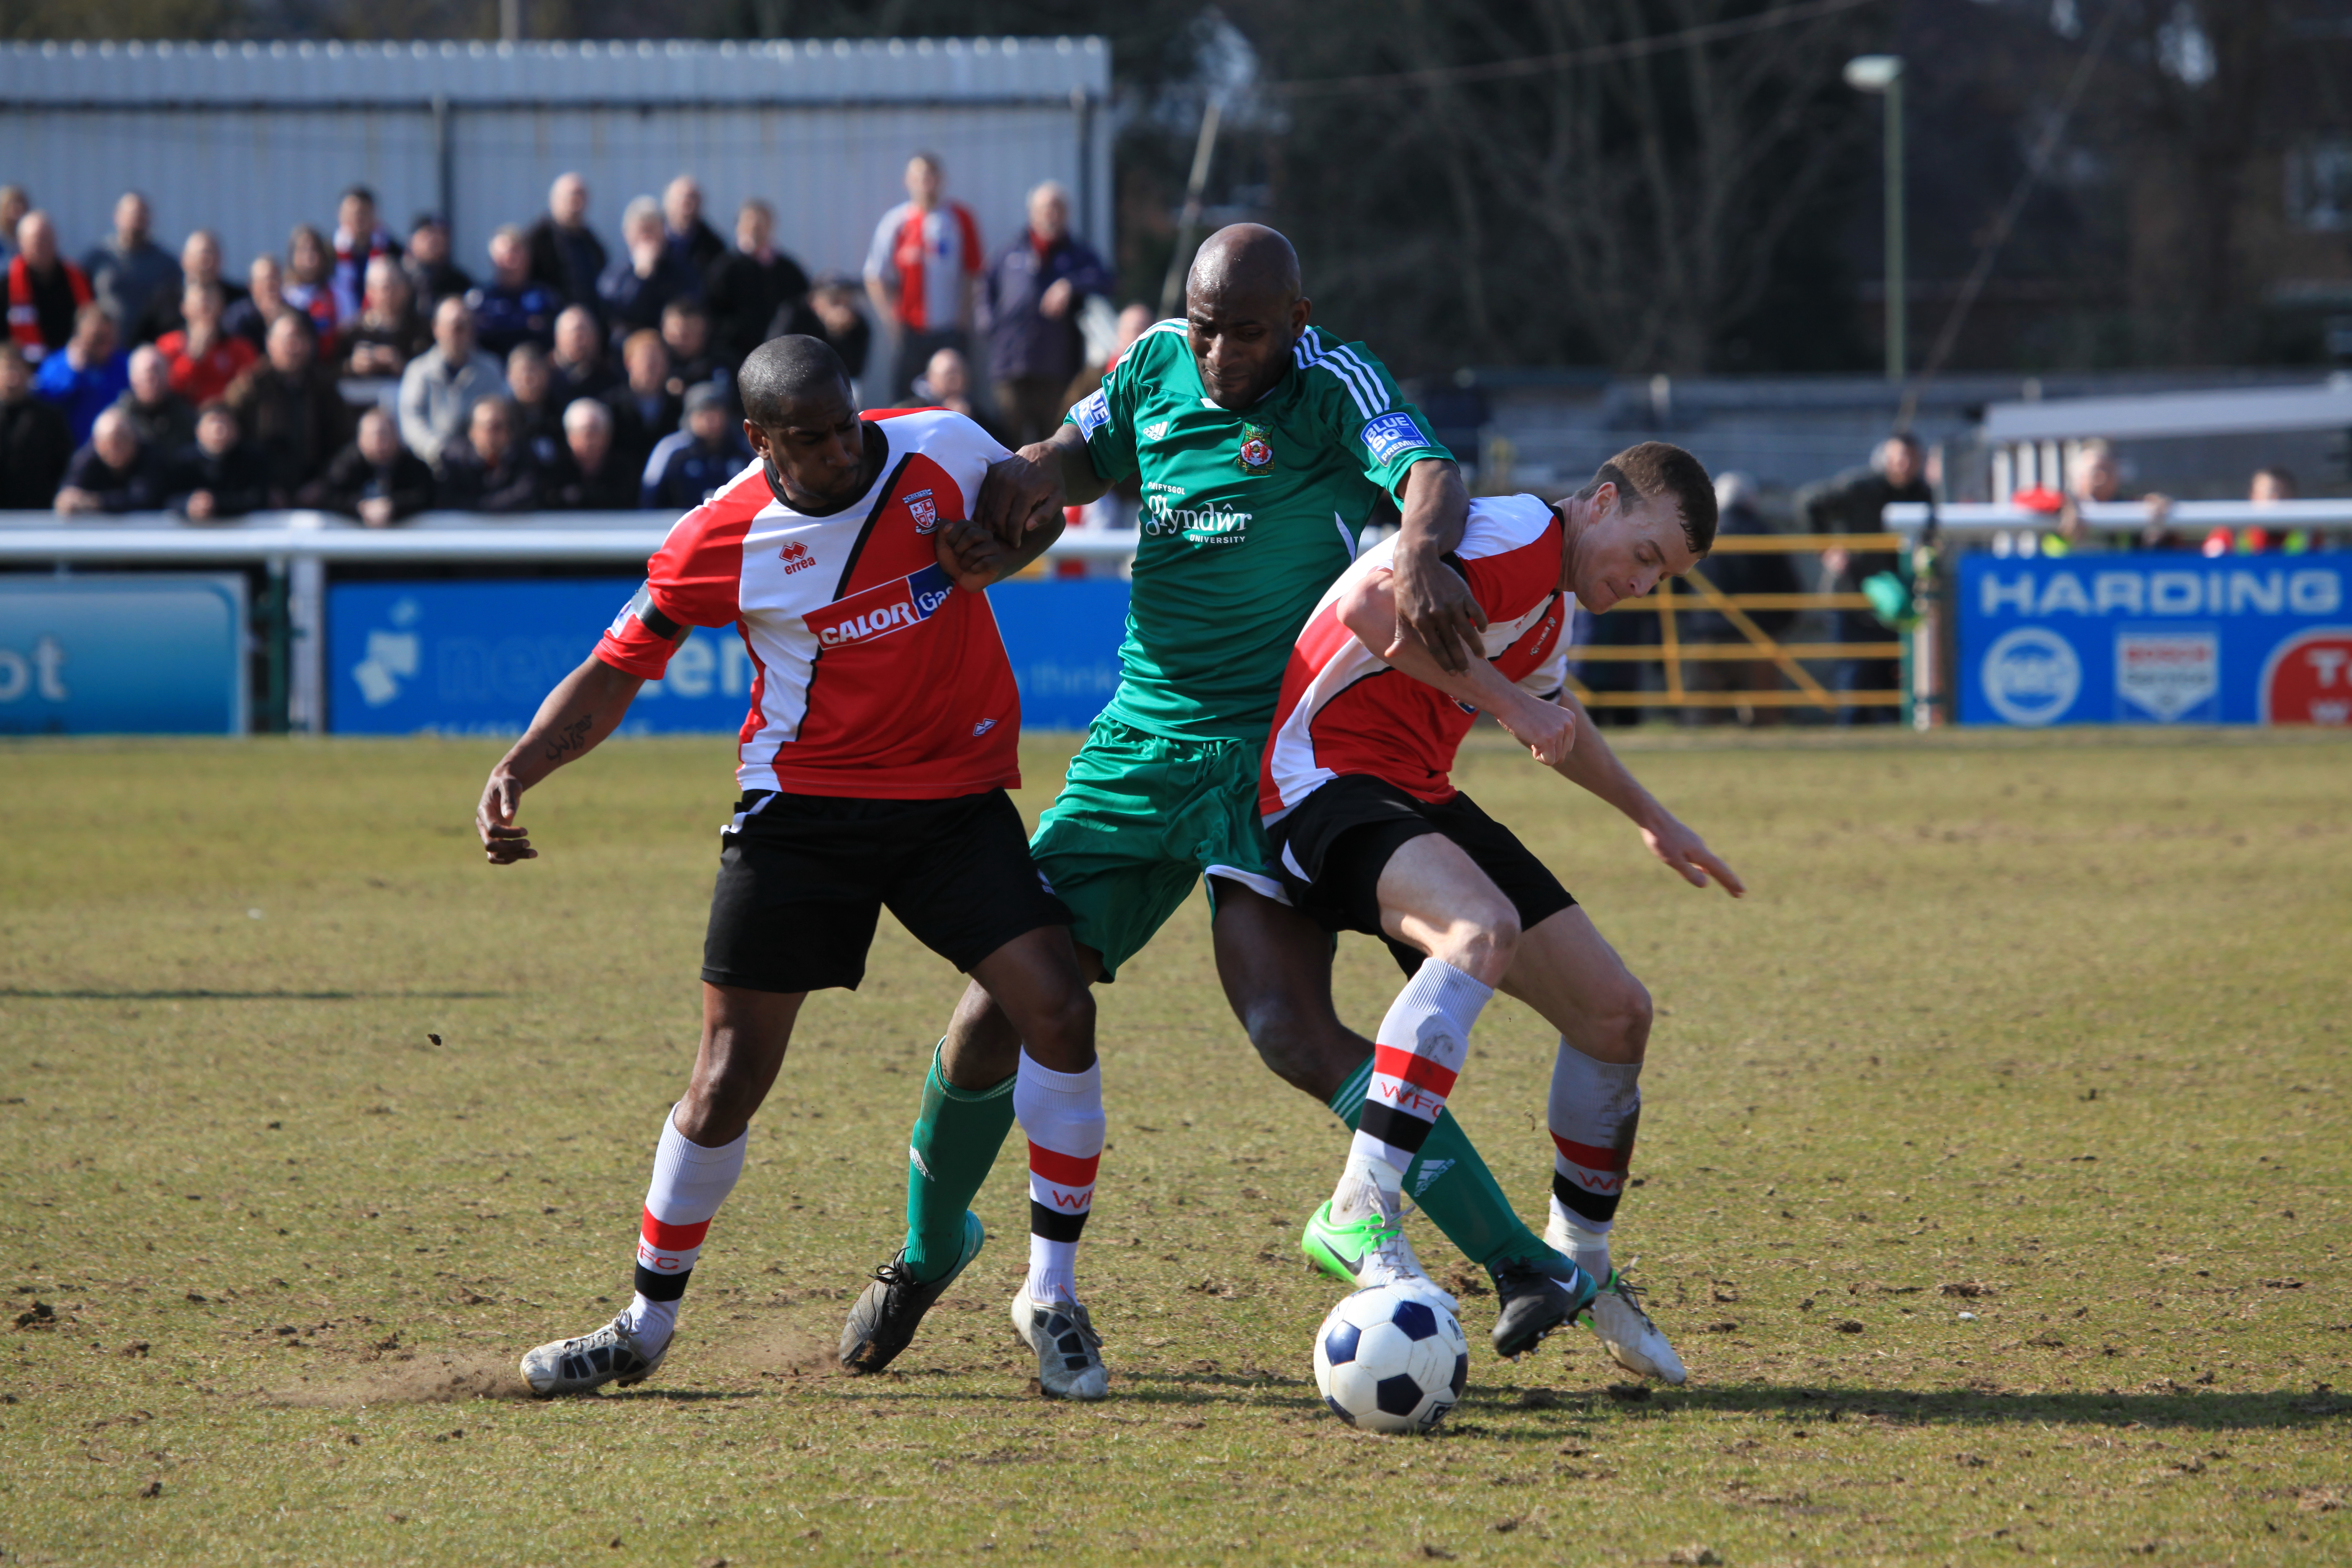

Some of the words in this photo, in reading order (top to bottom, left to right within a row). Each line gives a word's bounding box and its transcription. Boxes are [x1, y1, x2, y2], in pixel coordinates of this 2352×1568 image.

[1364, 416, 1410, 443] BLUE
[1381, 440, 1425, 462] PREMIER
[907, 490, 927, 499] WOKING
[1148, 482, 1185, 495] PRIFYSGOL
[1145, 495, 1252, 536] glyndŵr
[1189, 534, 1246, 544] UNIVERSITY
[784, 557, 816, 575] errea
[1980, 570, 2341, 616] HARDING
[820, 602, 918, 645] CALOR
[1381, 1082, 1444, 1118] WFC
[637, 1242, 680, 1270] FC
